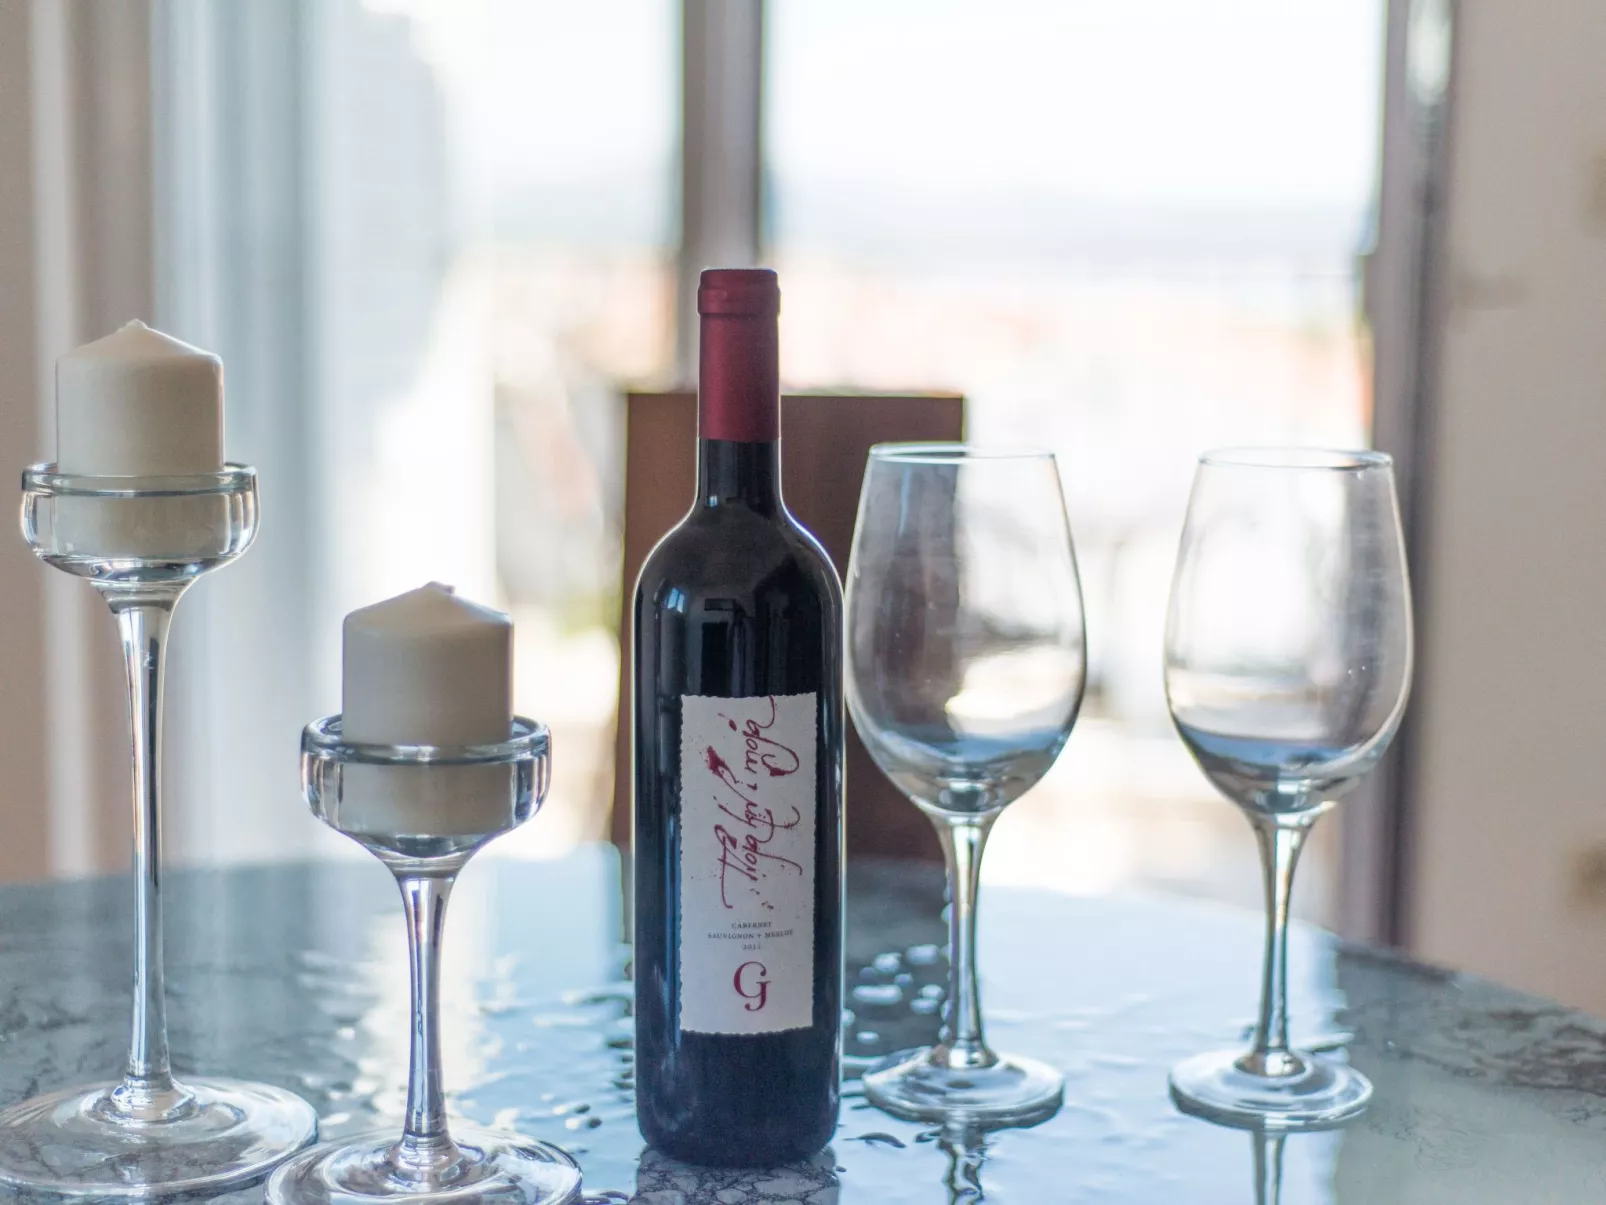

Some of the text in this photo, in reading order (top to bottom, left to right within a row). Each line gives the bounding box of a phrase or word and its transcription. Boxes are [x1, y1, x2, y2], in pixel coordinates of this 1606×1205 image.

[731, 921, 772, 929] CABERNET
[764, 929, 793, 938] MERLOT
[733, 961, 772, 1011] G
